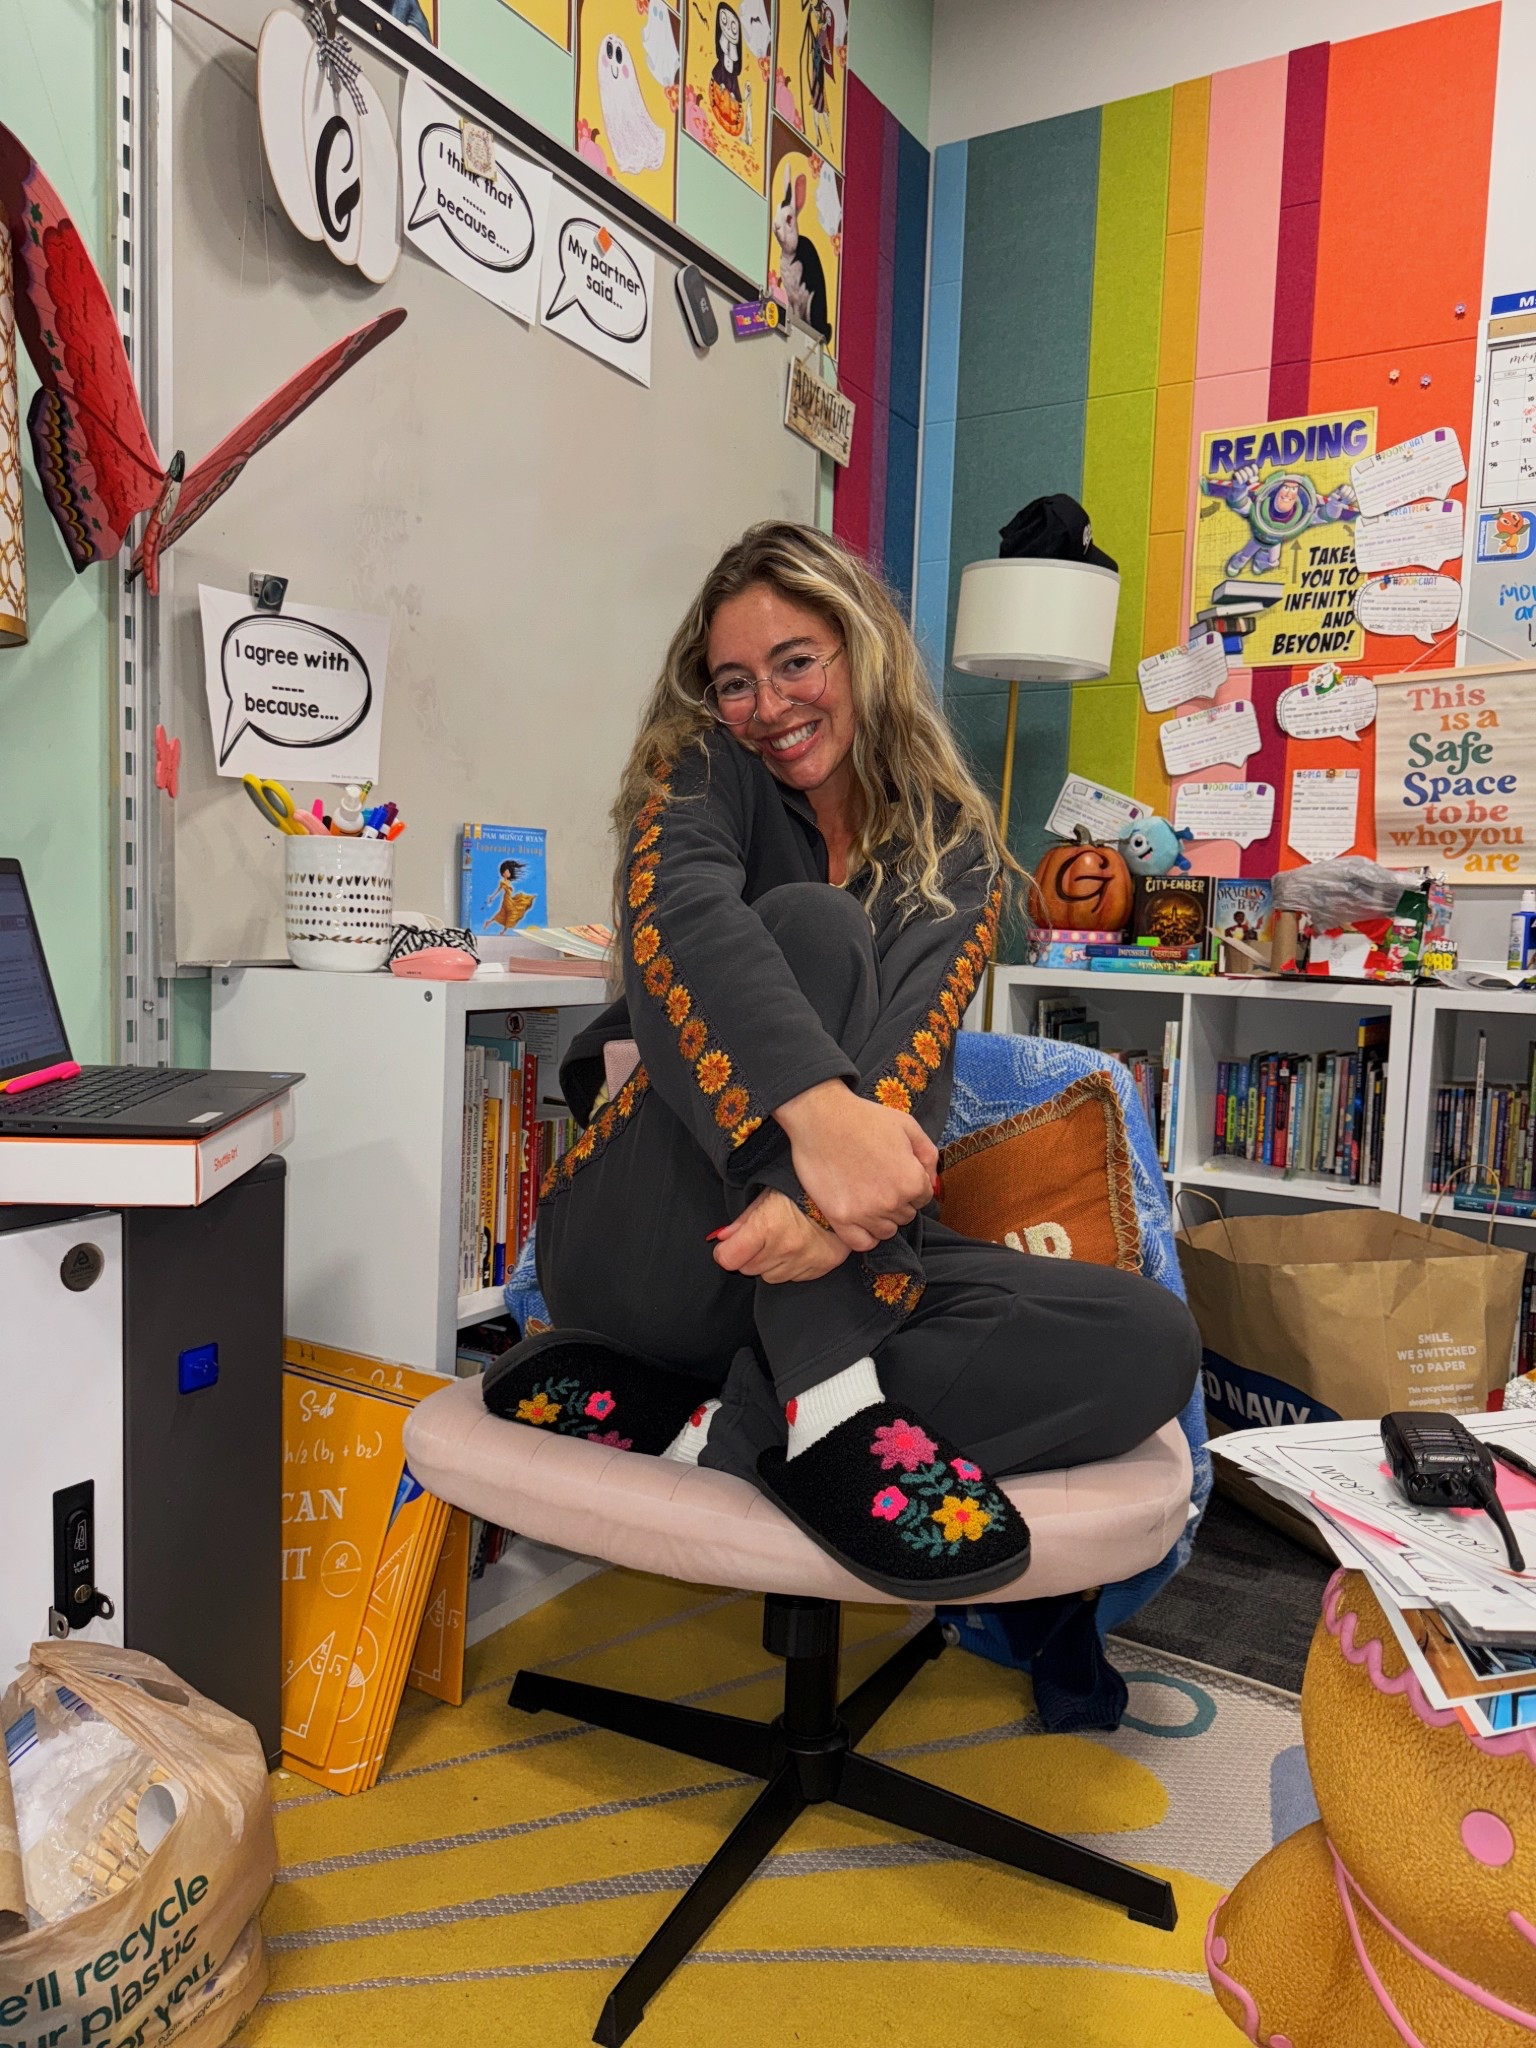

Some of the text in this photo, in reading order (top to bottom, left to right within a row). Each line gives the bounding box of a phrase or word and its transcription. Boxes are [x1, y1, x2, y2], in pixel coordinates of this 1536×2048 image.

[438, 141, 444, 159] I
[484, 178, 514, 211] that
[567, 234, 641, 297] My partner
[1519, 296, 1536, 309] M
[793, 368, 851, 441] ADVENTURE
[1208, 419, 1368, 474] READING
[1309, 546, 1357, 566] TAKES
[1300, 568, 1360, 588] YOU TO
[1284, 589, 1357, 612] INFINITY
[1321, 611, 1356, 629] AND
[1272, 630, 1356, 656] BEYOND!
[235, 639, 349, 672] I agree with
[1406, 683, 1486, 711] This
[1439, 709, 1499, 732] is a
[1407, 731, 1494, 775] Safe
[1402, 771, 1517, 807] Space
[1422, 799, 1509, 825] to be
[499, 833, 523, 842] MUÑOZ
[1388, 824, 1525, 860] who you
[1464, 852, 1520, 872] are
[1055, 850, 1114, 914] G
[1145, 880, 1205, 894] CITY EMBER
[1151, 949, 1182, 959] CREATURES
[472, 1112, 480, 1155] COUNTRIES
[1418, 1332, 1453, 1345] SMILE,
[1396, 1346, 1477, 1360] WE SWITCHED
[1410, 1361, 1466, 1374] TO PAPER
[1408, 1383, 1474, 1394] This recycled paper
[1224, 1380, 1311, 1427] NAVY
[1408, 1397, 1440, 1407] shopping
[1441, 1396, 1457, 1404] bag
[282, 1487, 347, 1524] CAN
[73, 1560, 85, 1568] LIFT
[74, 1565, 90, 1574] TURN
[75, 1874, 209, 1997] recycle
[81, 1924, 199, 2046] plastic
